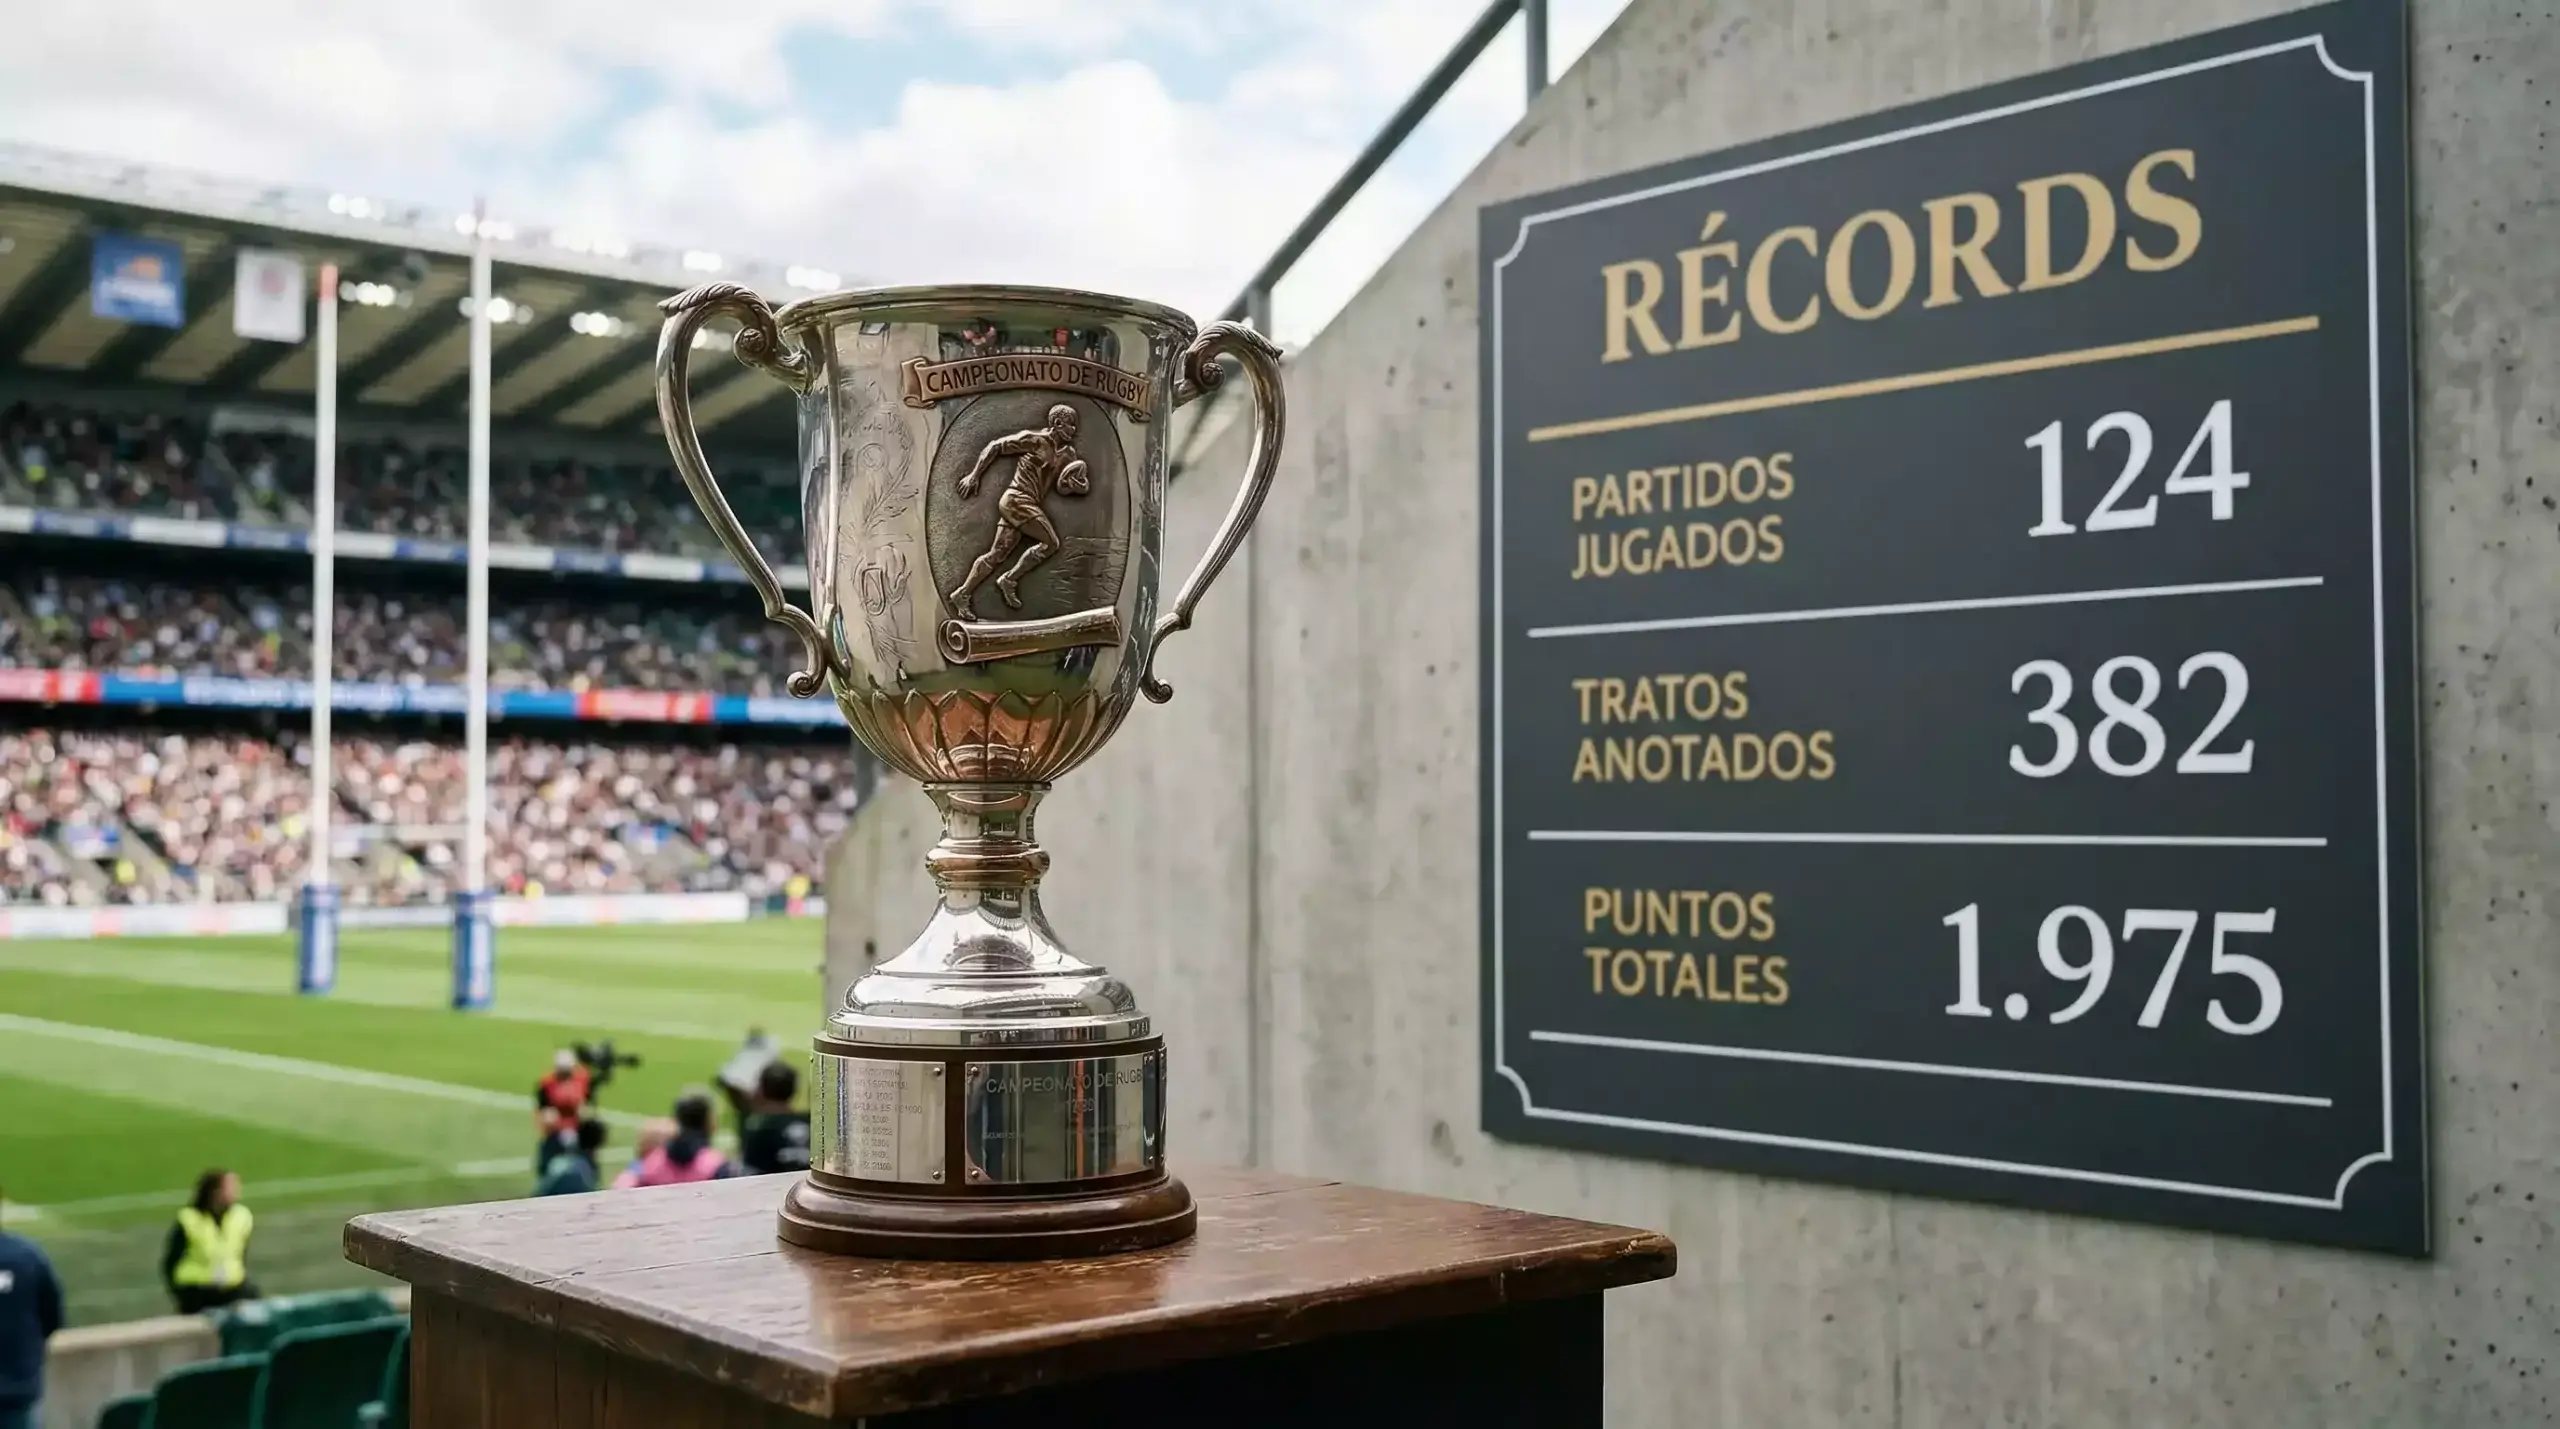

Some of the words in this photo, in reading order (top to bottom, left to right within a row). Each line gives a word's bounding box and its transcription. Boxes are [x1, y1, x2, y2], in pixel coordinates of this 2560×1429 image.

[1599, 148, 2203, 365] RÉCORDS
[926, 360, 1063, 393] CAMPEONATO
[1068, 365, 1091, 387] DE
[1095, 370, 1146, 405] RUGBY
[1571, 451, 1796, 522] PARTIDOS
[2023, 399, 2252, 538] 124
[1570, 514, 1785, 581] JUGADOS
[1571, 671, 1749, 724] TRATOS
[2007, 651, 2256, 779] 382
[1571, 730, 1836, 783] ANOTADOS
[1584, 887, 1776, 941] PUNTOS
[1584, 947, 1789, 1005] TOTALES
[1941, 901, 2284, 1037] 1.975
[986, 1074, 1092, 1094] CAMPEONAO
